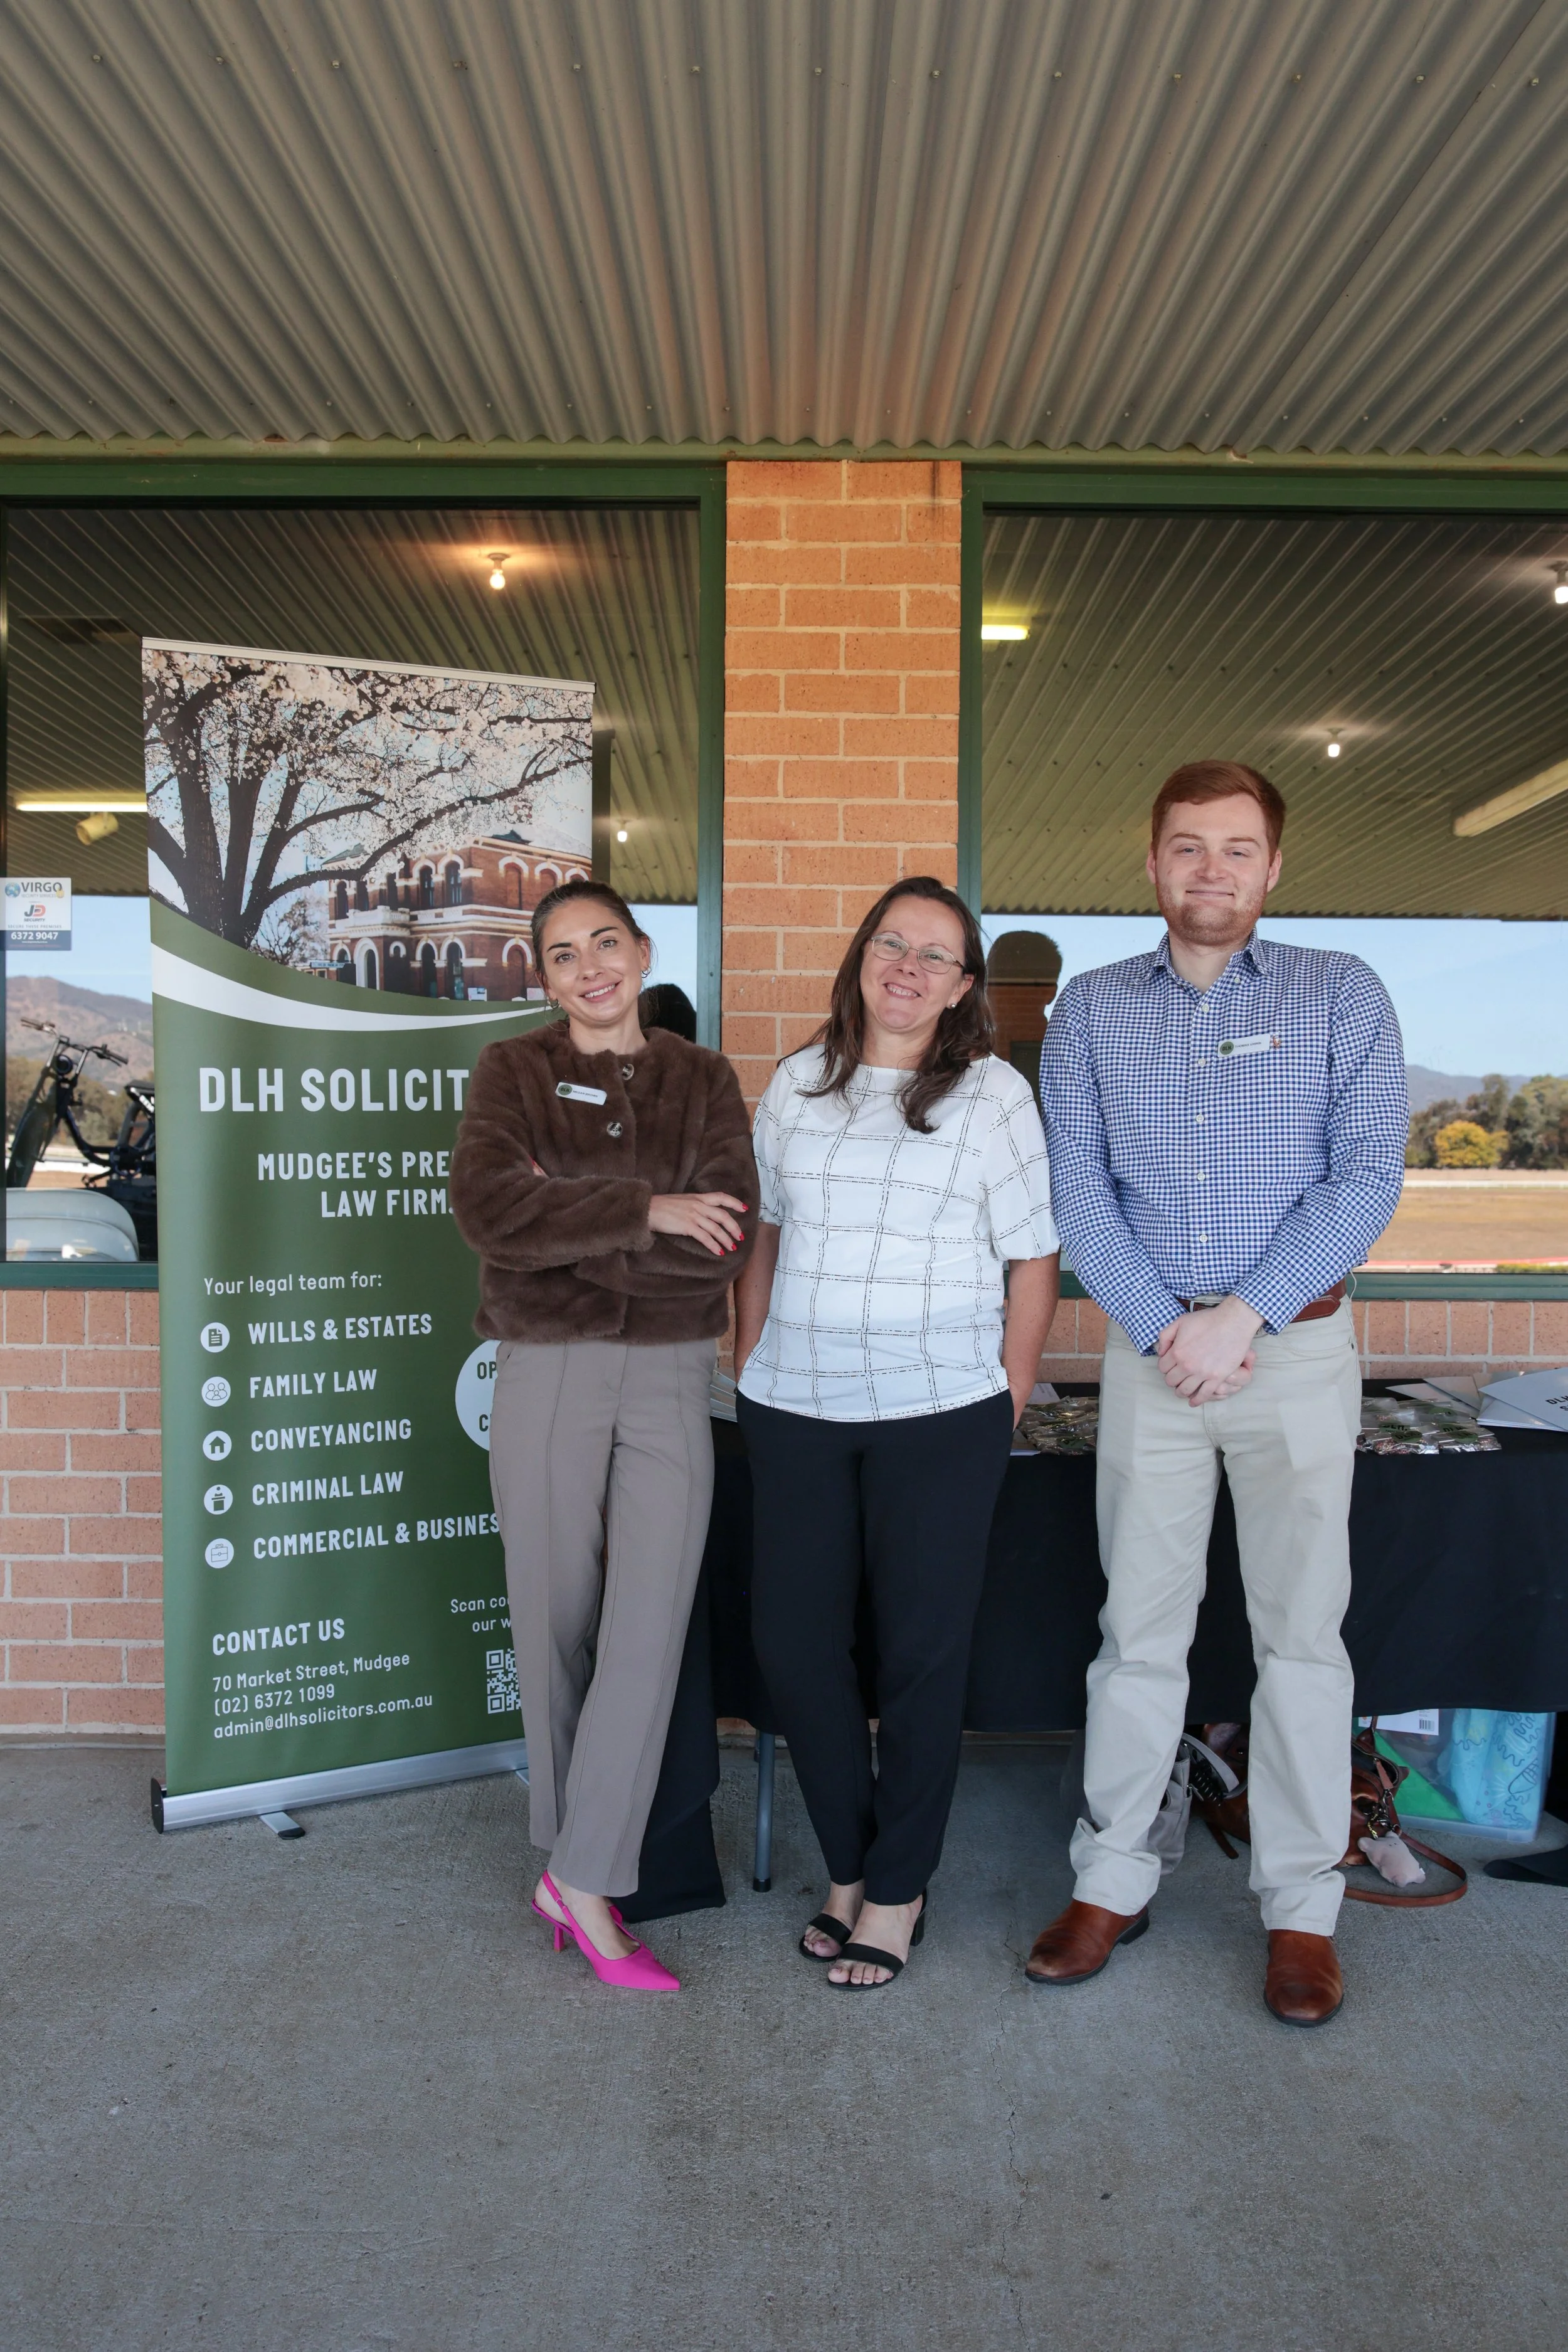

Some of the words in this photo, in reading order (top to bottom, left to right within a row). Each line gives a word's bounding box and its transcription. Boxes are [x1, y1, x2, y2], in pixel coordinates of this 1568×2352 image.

[21, 882, 62, 893] VIRGO
[11, 931, 34, 940] 6372
[35, 931, 58, 940] 9047
[199, 1067, 283, 1112] DLH
[258, 1152, 392, 1181] MUDGEE'S
[402, 1150, 454, 1178] PRE
[321, 1190, 377, 1218] LAW
[203, 1278, 245, 1295] Your
[250, 1274, 293, 1296] legal
[298, 1274, 345, 1290] team
[350, 1271, 382, 1288] for:
[248, 1320, 316, 1345] WILLS
[322, 1318, 339, 1340] &
[345, 1313, 432, 1339] ESTATES
[250, 1372, 326, 1399] FAMILY
[334, 1369, 377, 1392] LAW
[251, 1419, 411, 1452] CONVEYANCING
[252, 1476, 354, 1506] CRIMINAL
[360, 1471, 404, 1495] LAW
[253, 1525, 389, 1559] COMMERCIAL
[395, 1522, 410, 1544] &
[450, 1599, 485, 1614] Scan
[490, 1597, 509, 1608] co
[213, 1622, 311, 1656] CONTACT
[318, 1618, 345, 1641] US
[472, 1619, 497, 1633] our
[213, 1675, 231, 1692] 70
[236, 1668, 292, 1688] Market
[295, 1660, 349, 1680] Street,
[353, 1654, 410, 1673] Mudgee
[214, 1694, 248, 1717] (02)
[254, 1690, 293, 1710] 6372
[299, 1683, 335, 1703] 1099
[214, 1695, 433, 1739] admin@dlhsolicitors.com.au
